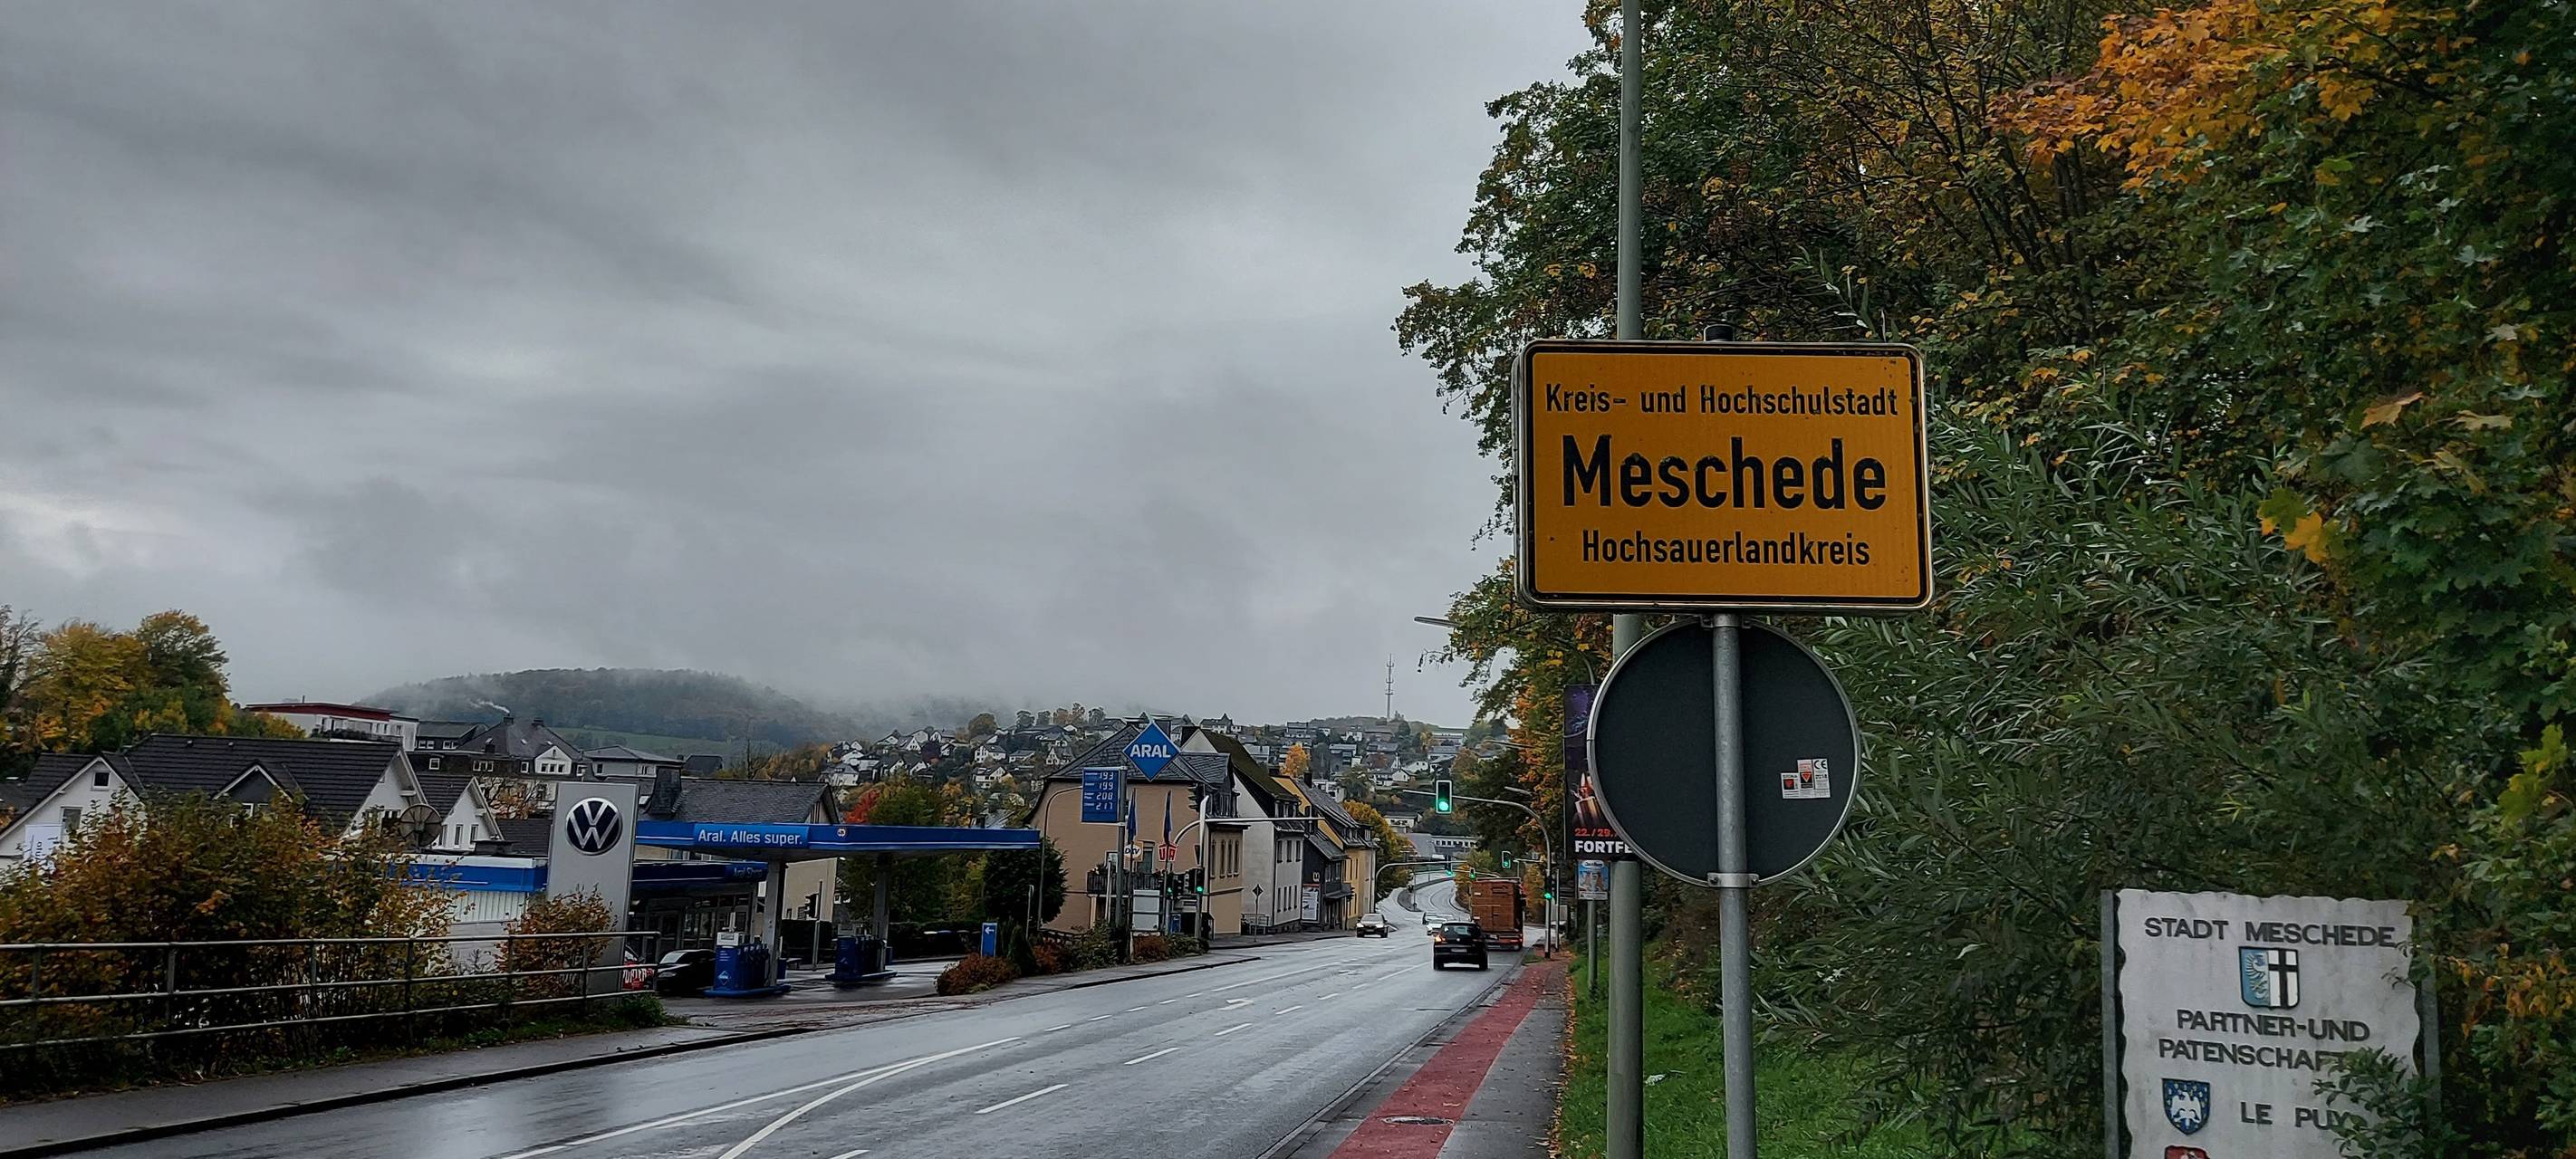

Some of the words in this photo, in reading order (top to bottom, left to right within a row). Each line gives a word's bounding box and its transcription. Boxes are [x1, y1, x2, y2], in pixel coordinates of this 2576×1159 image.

[1546, 384, 1627, 413] Kreis-
[1640, 385, 1687, 414] und
[1700, 385, 1898, 416] Hochschulstadt
[1562, 435, 1886, 510] Meschede
[1582, 530, 1870, 565] Hochsauerlandkreis
[1129, 744, 1171, 758] ARAL
[1100, 771, 1114, 780] 193
[1096, 792, 1113, 800] 208
[697, 829, 726, 842] Aral.
[730, 830, 761, 843] Alles
[764, 833, 803, 846] super.
[2144, 917, 2229, 940] STADT
[2245, 922, 2396, 948] MESCHEDE
[2177, 1010, 2370, 1041] PARTNER-UND
[2240, 1101, 2273, 1125] LE
